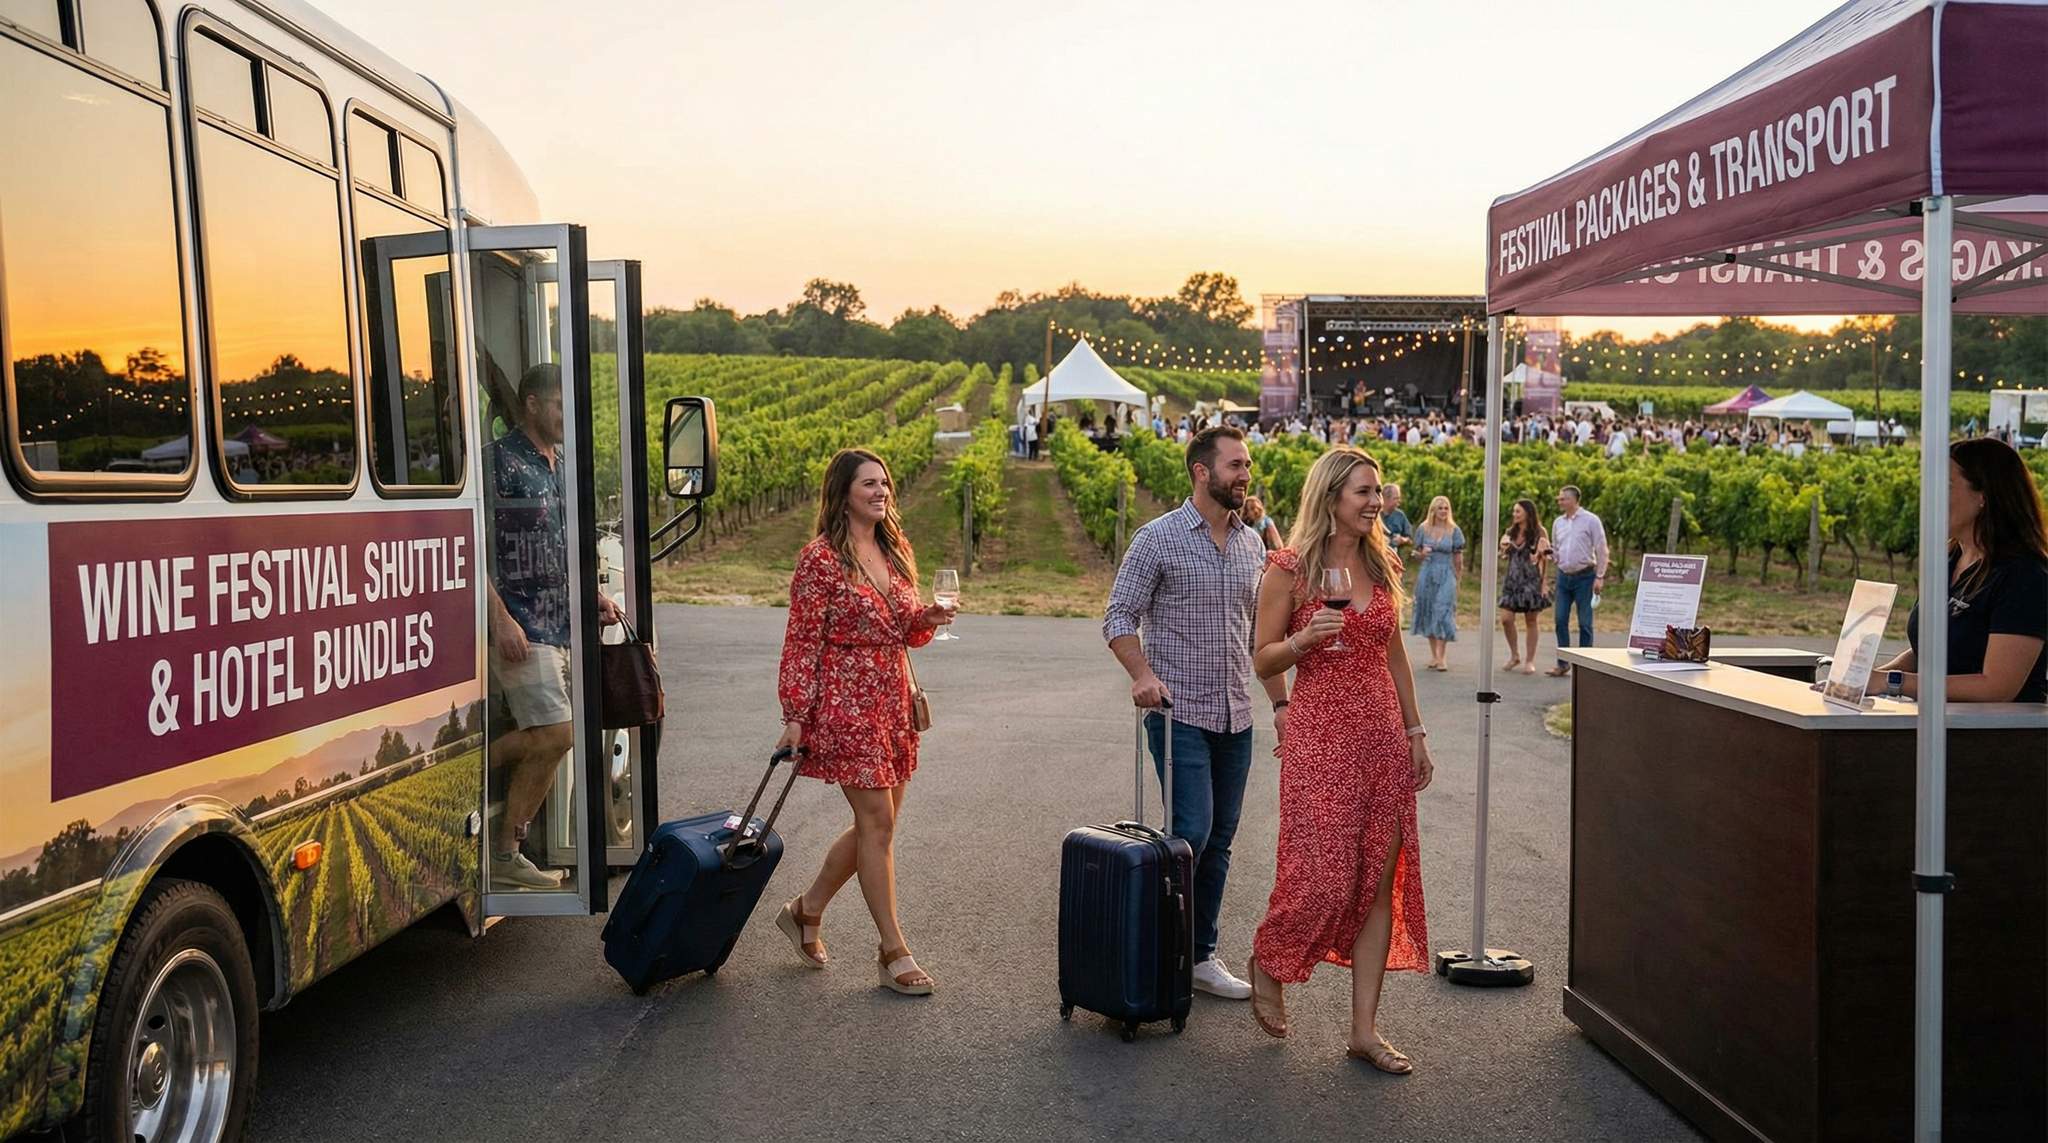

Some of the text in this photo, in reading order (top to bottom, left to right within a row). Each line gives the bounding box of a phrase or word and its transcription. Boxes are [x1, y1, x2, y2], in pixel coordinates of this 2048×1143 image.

[1499, 74, 1897, 277] FESTIVAL PACKAGES & TRANSPORT
[77, 556, 196, 645] WINE
[208, 544, 357, 626] FESTIVAL
[364, 535, 467, 603] SHUTTLE
[148, 611, 434, 737] & HOTEL BUNDLES
